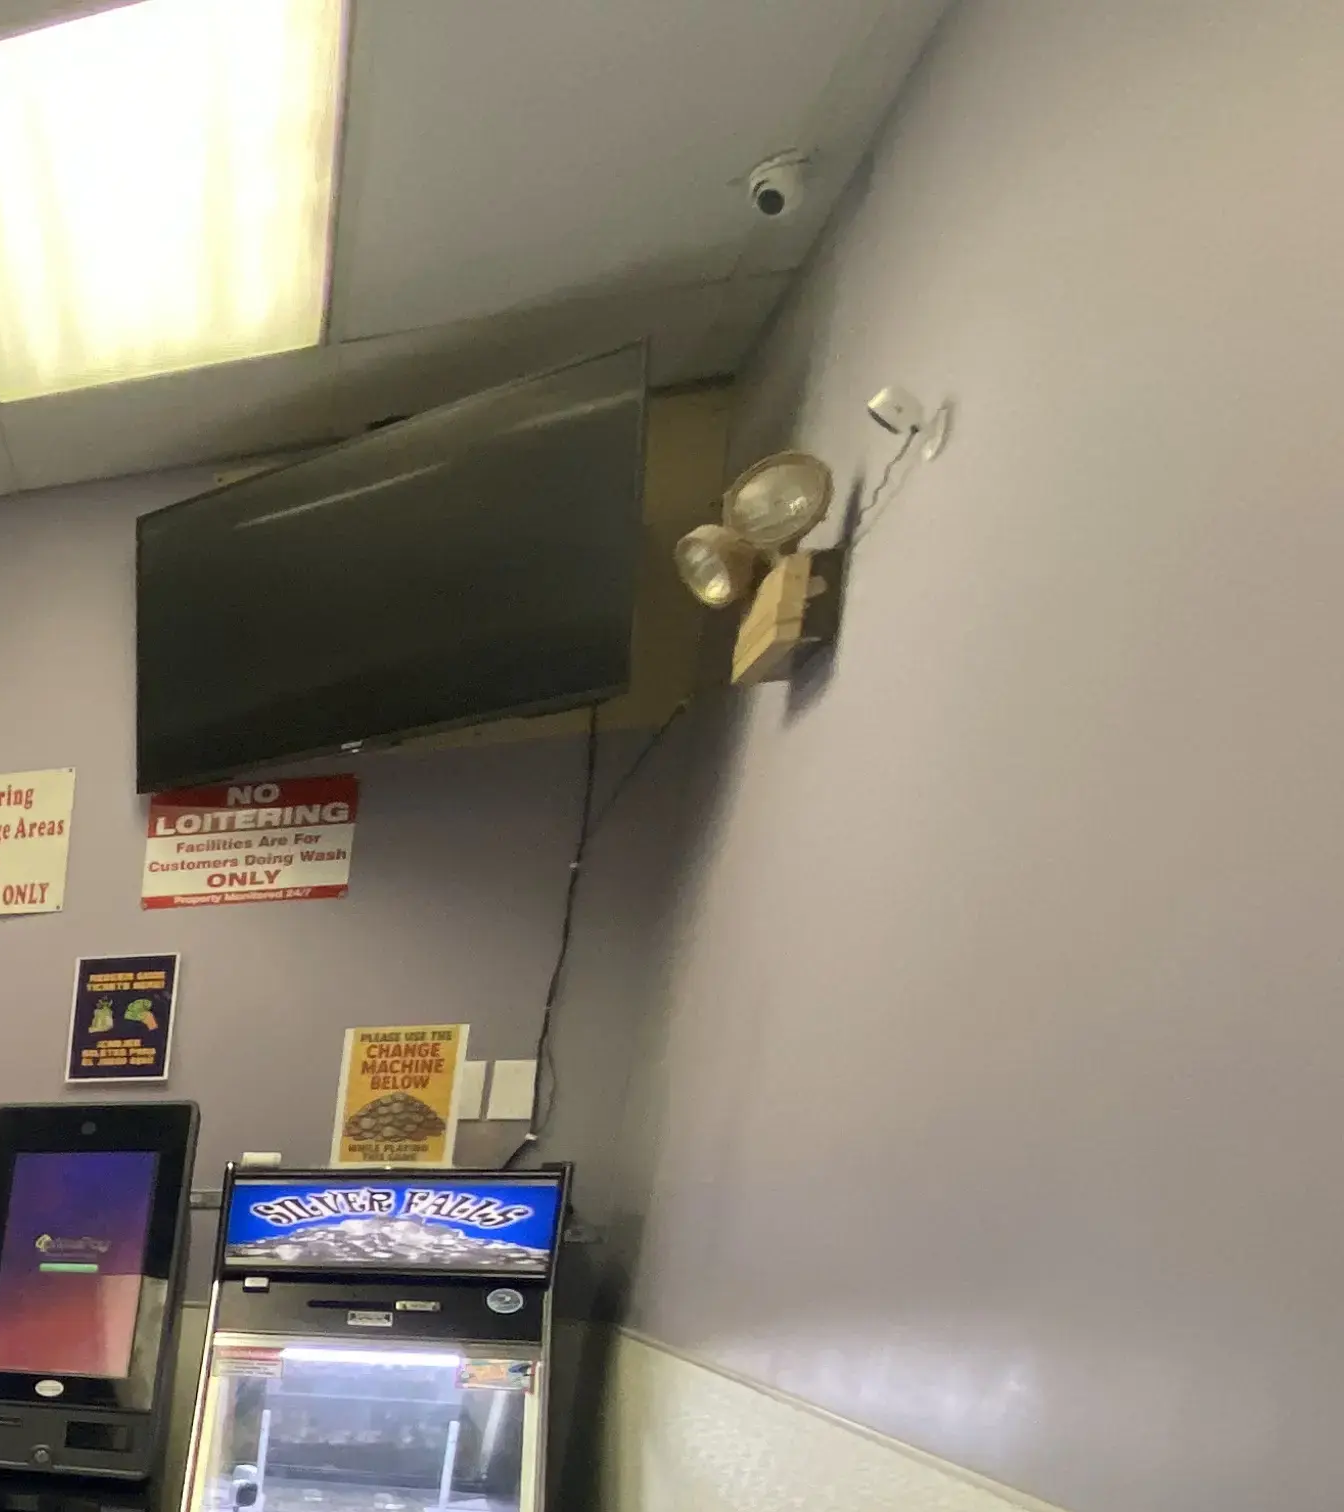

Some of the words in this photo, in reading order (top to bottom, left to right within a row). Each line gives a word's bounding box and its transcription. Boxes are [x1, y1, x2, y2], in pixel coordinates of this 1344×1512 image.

[227, 783, 280, 806] NO
[14, 817, 64, 839] Areas
[155, 801, 349, 836] LOITERING
[176, 838, 253, 854] Facilities
[258, 835, 288, 848] Are
[294, 832, 322, 845] For
[148, 857, 239, 873] Customers
[245, 853, 294, 867] Doing
[300, 848, 347, 863] Wash
[207, 869, 282, 888] ONLY
[2, 882, 50, 906] ONLY
[360, 1031, 402, 1043] PLEASE
[404, 1031, 426, 1041] USE
[430, 1030, 452, 1040] THE
[366, 1042, 441, 1058] CHANGE
[361, 1059, 445, 1075] MACHINE
[370, 1074, 430, 1090] BELOW
[251, 1188, 396, 1227] SILVER
[403, 1189, 534, 1229] FALLS
